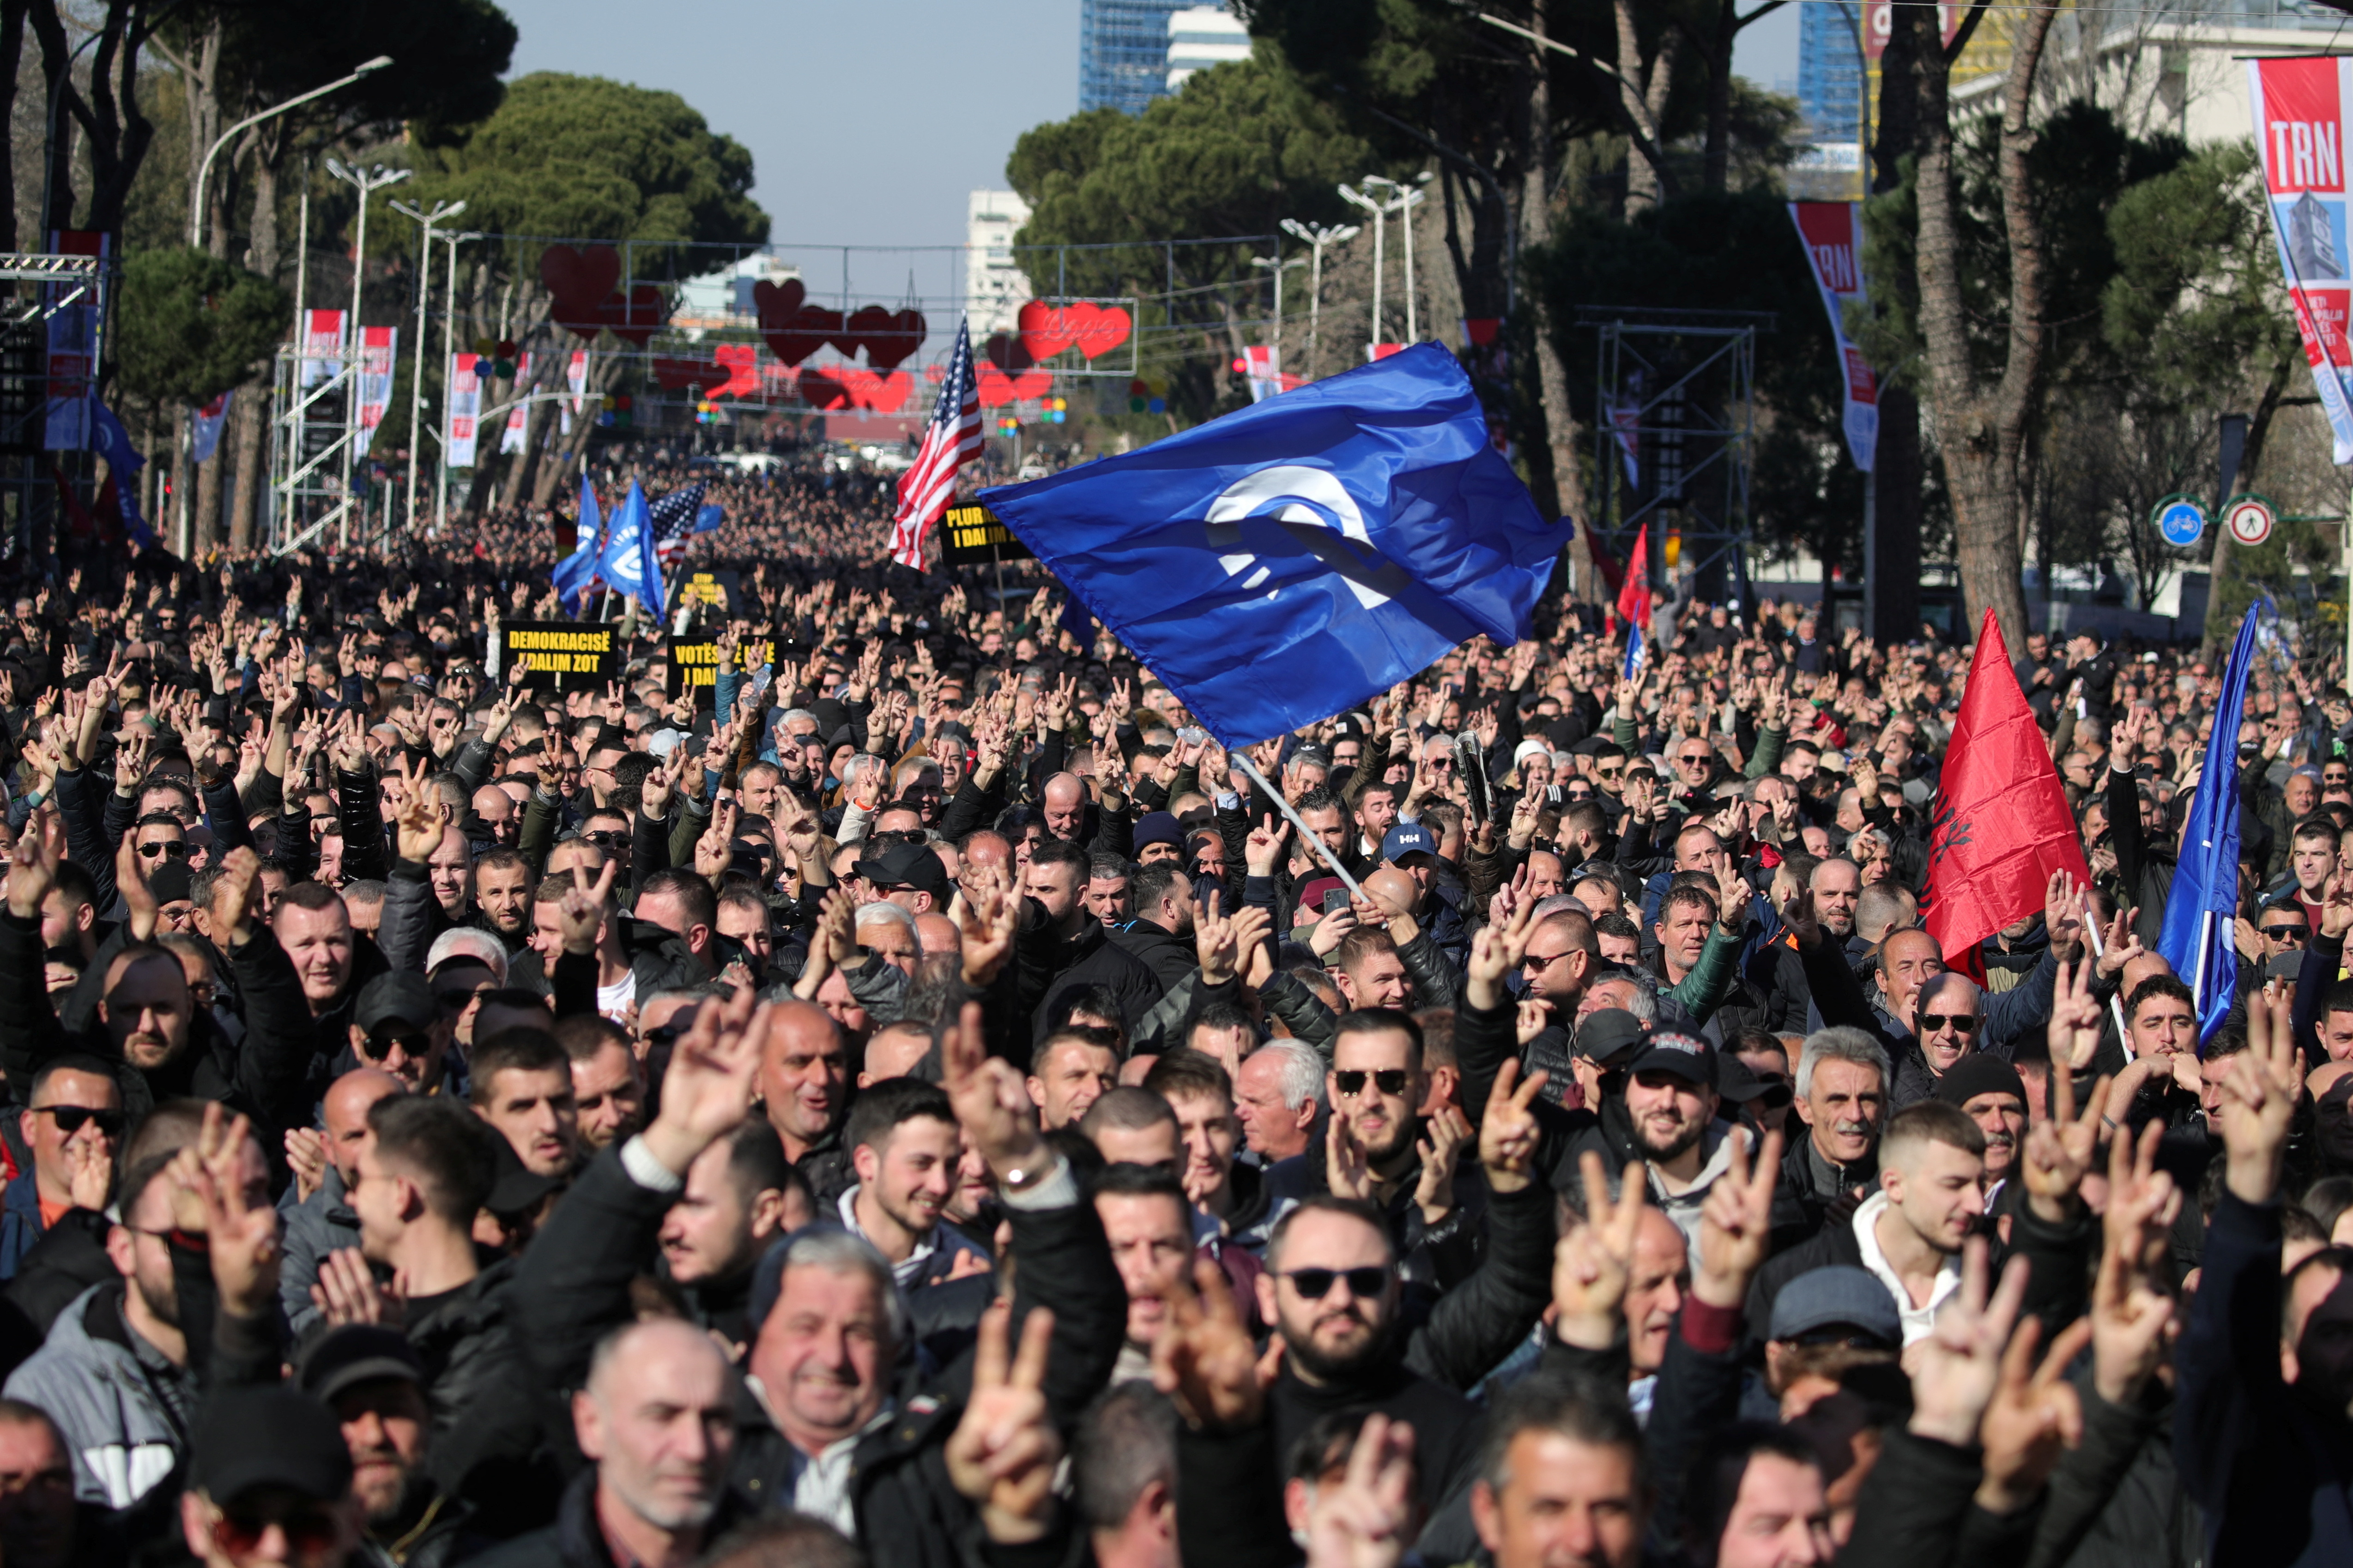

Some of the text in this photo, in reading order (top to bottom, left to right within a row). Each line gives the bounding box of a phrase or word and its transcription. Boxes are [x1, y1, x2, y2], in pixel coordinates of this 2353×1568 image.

[2270, 121, 2339, 187] TRN
[953, 530, 961, 548] I
[962, 525, 1006, 547] DALIM
[509, 631, 611, 652] DEMOKRACISË
[526, 653, 571, 671] DALIM
[573, 654, 600, 673] ZOT
[1399, 834, 1420, 844] HH
